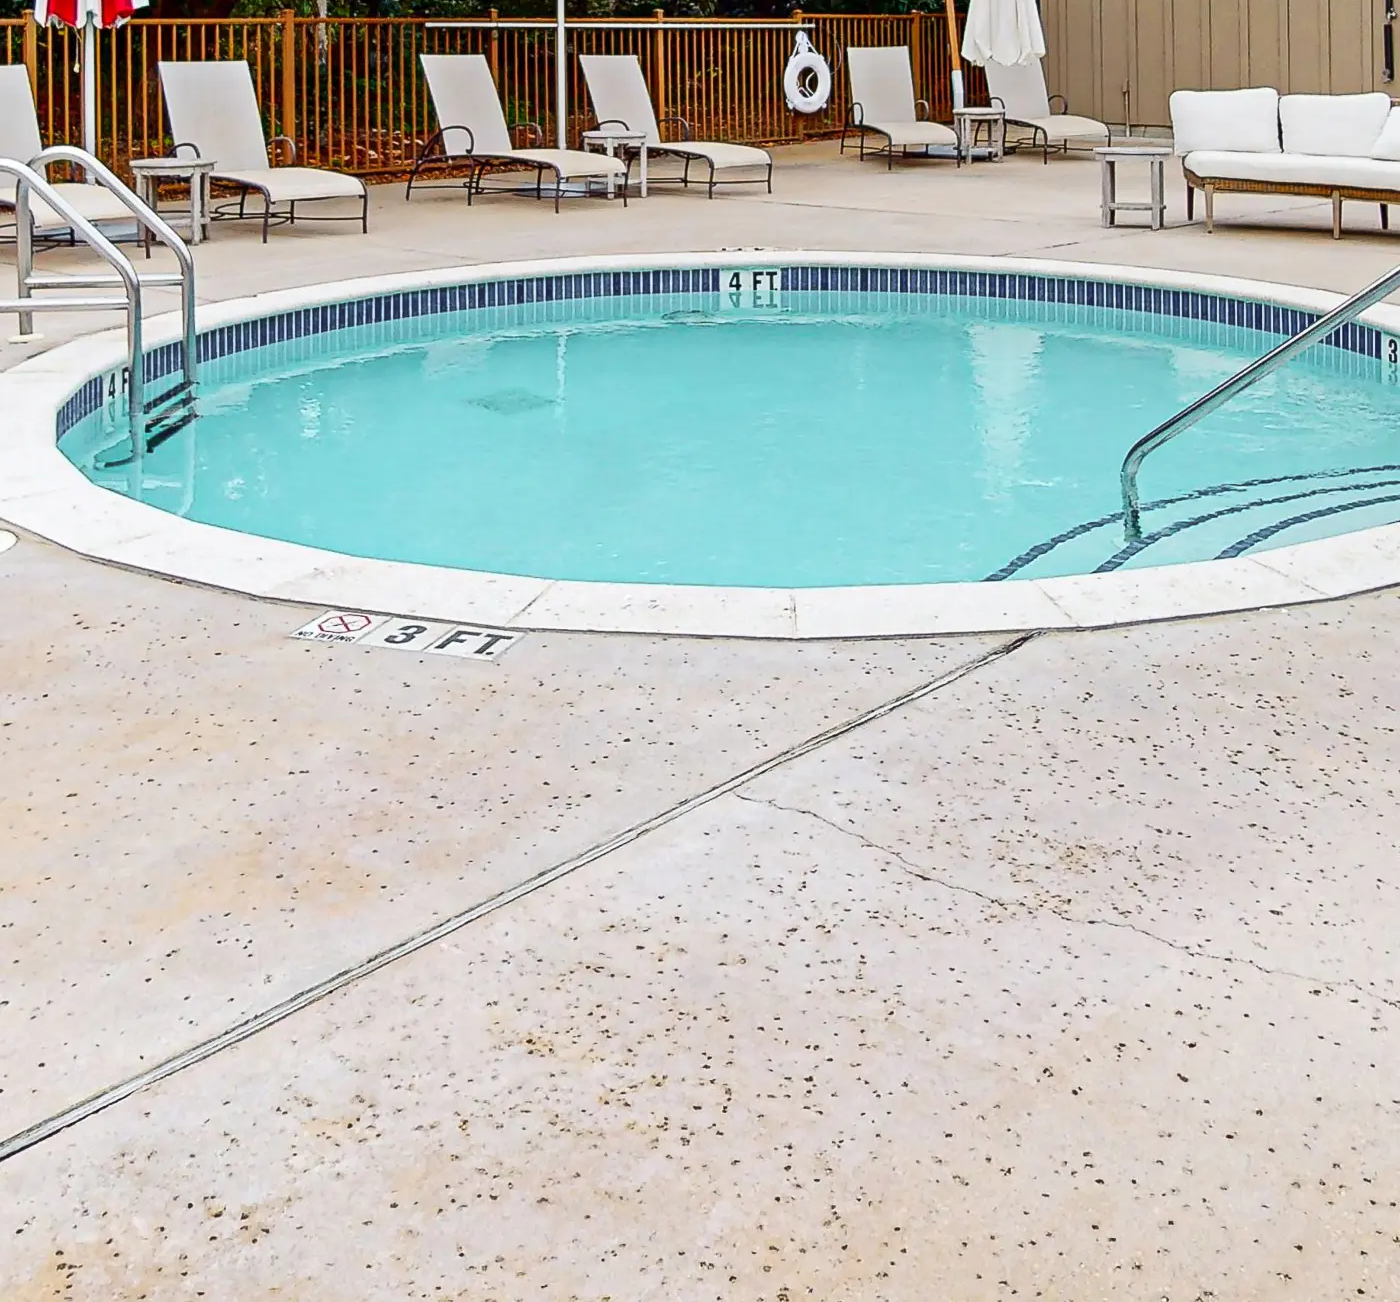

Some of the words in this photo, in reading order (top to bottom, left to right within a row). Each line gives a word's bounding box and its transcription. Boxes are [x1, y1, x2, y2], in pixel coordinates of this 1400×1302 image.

[728, 271, 742, 291] 4
[1388, 338, 1398, 364] 3
[108, 372, 116, 398] 4
[383, 624, 428, 645] 3
[433, 630, 514, 656] FT.
